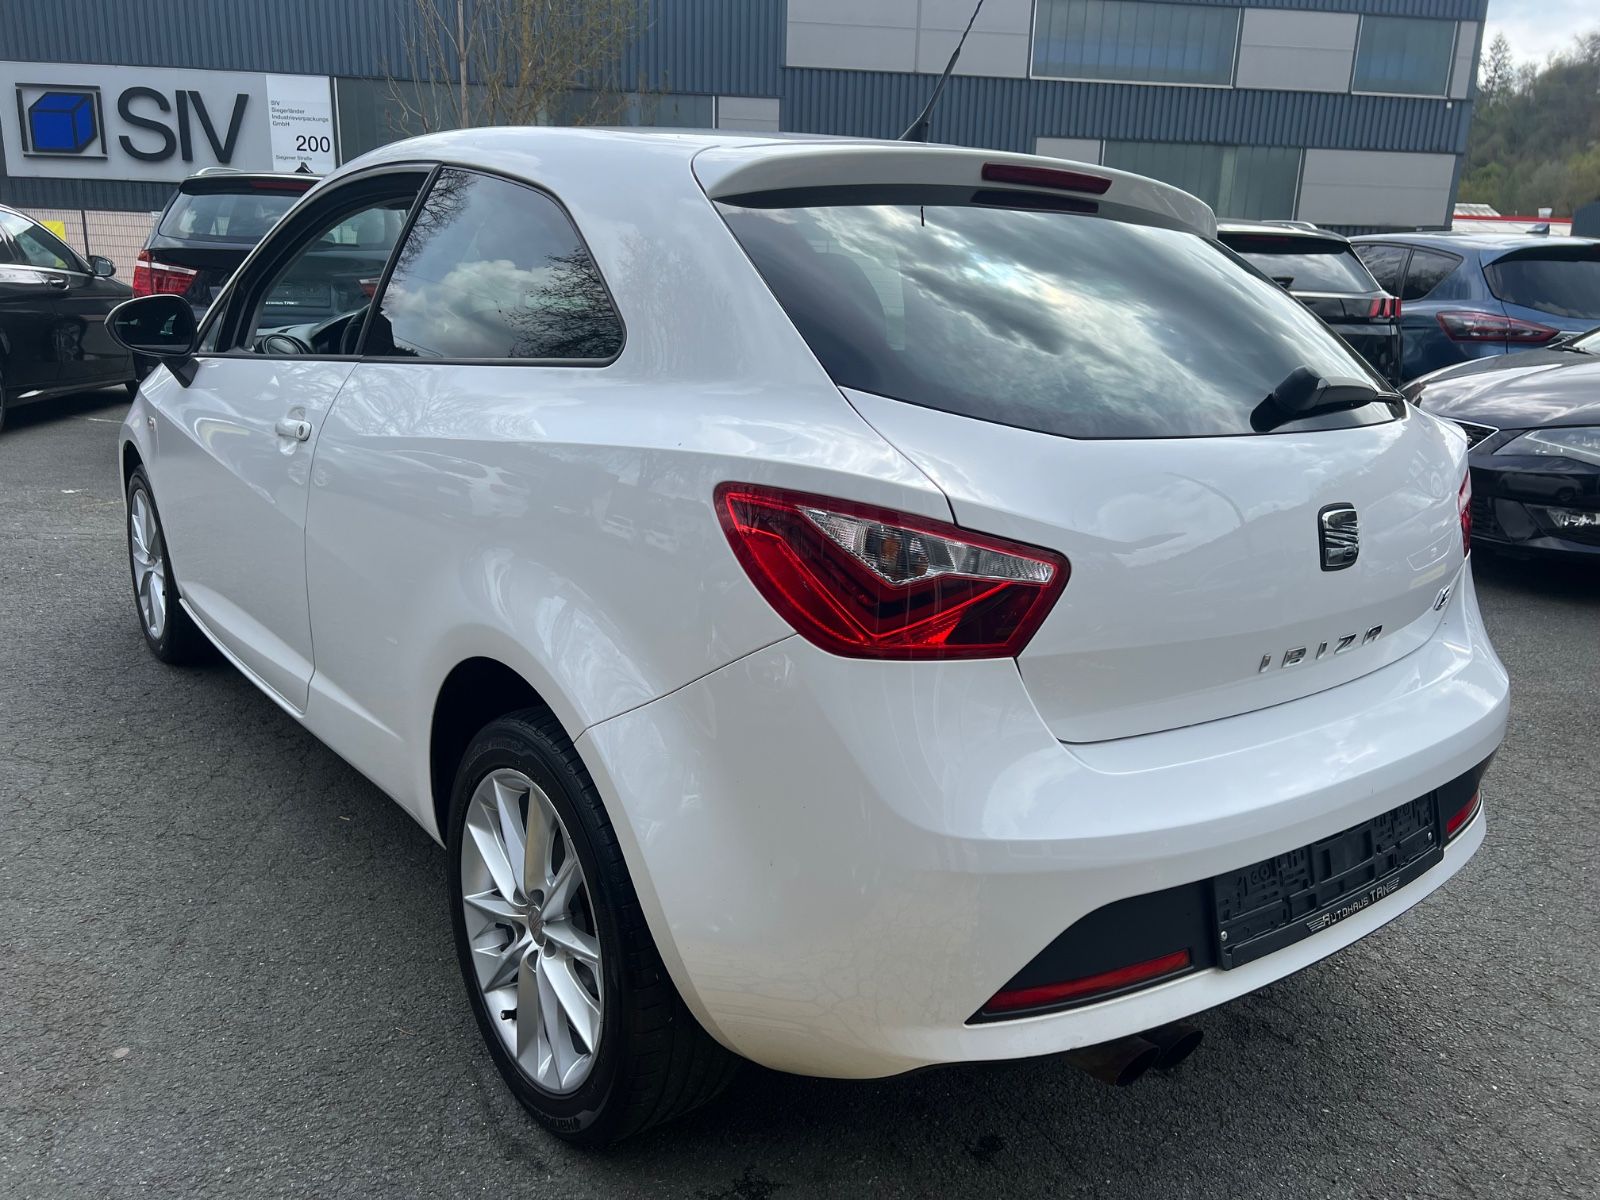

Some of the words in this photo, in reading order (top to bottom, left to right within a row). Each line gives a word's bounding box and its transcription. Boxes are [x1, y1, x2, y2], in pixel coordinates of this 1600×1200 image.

[117, 86, 249, 164] SIV
[295, 135, 331, 153] 200
[1259, 625, 1383, 673] IBIZA
